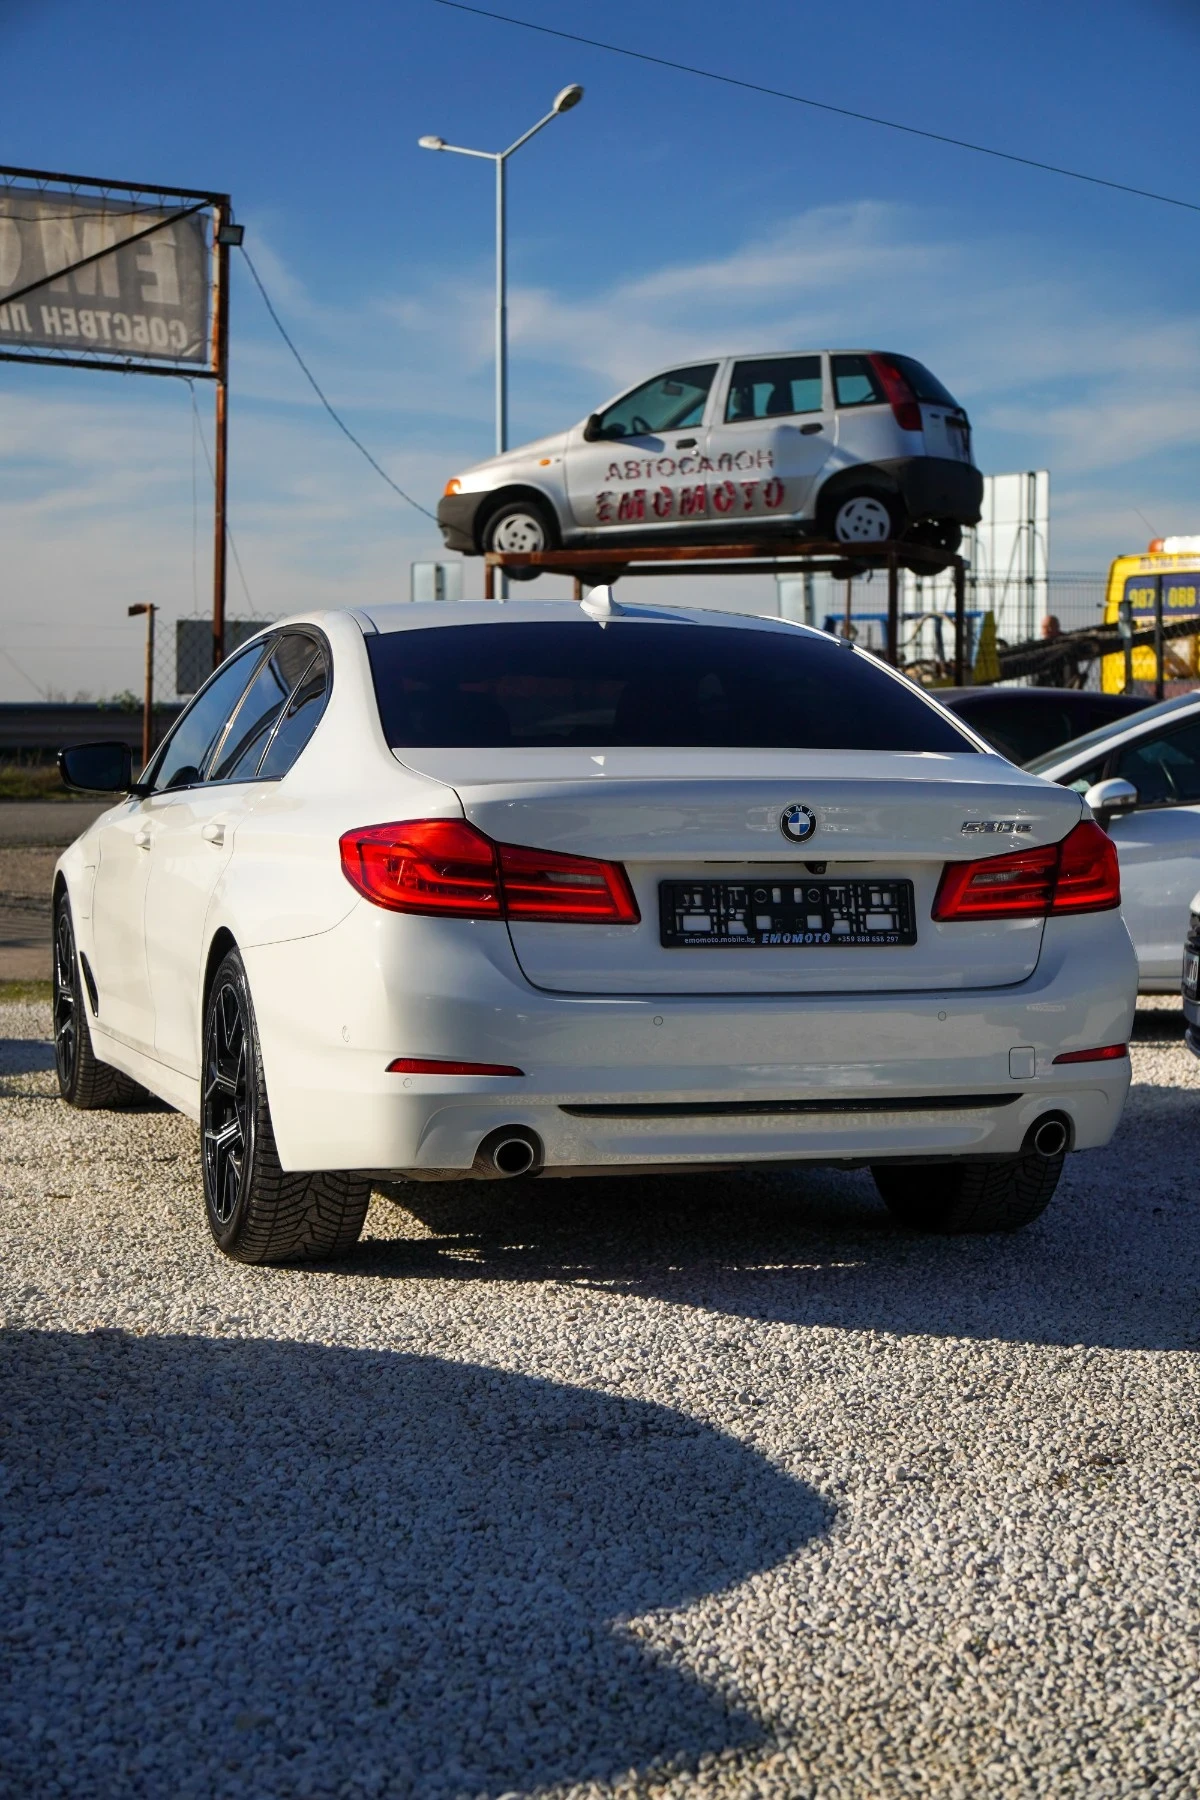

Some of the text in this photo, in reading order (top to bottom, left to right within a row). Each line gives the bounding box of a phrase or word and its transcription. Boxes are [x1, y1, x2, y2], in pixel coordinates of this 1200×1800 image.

[605, 449, 774, 481] АВТОСАЛОН
[684, 936, 756, 944] emomoto.mobile.bg
[762, 933, 831, 944] EMOMOTO
